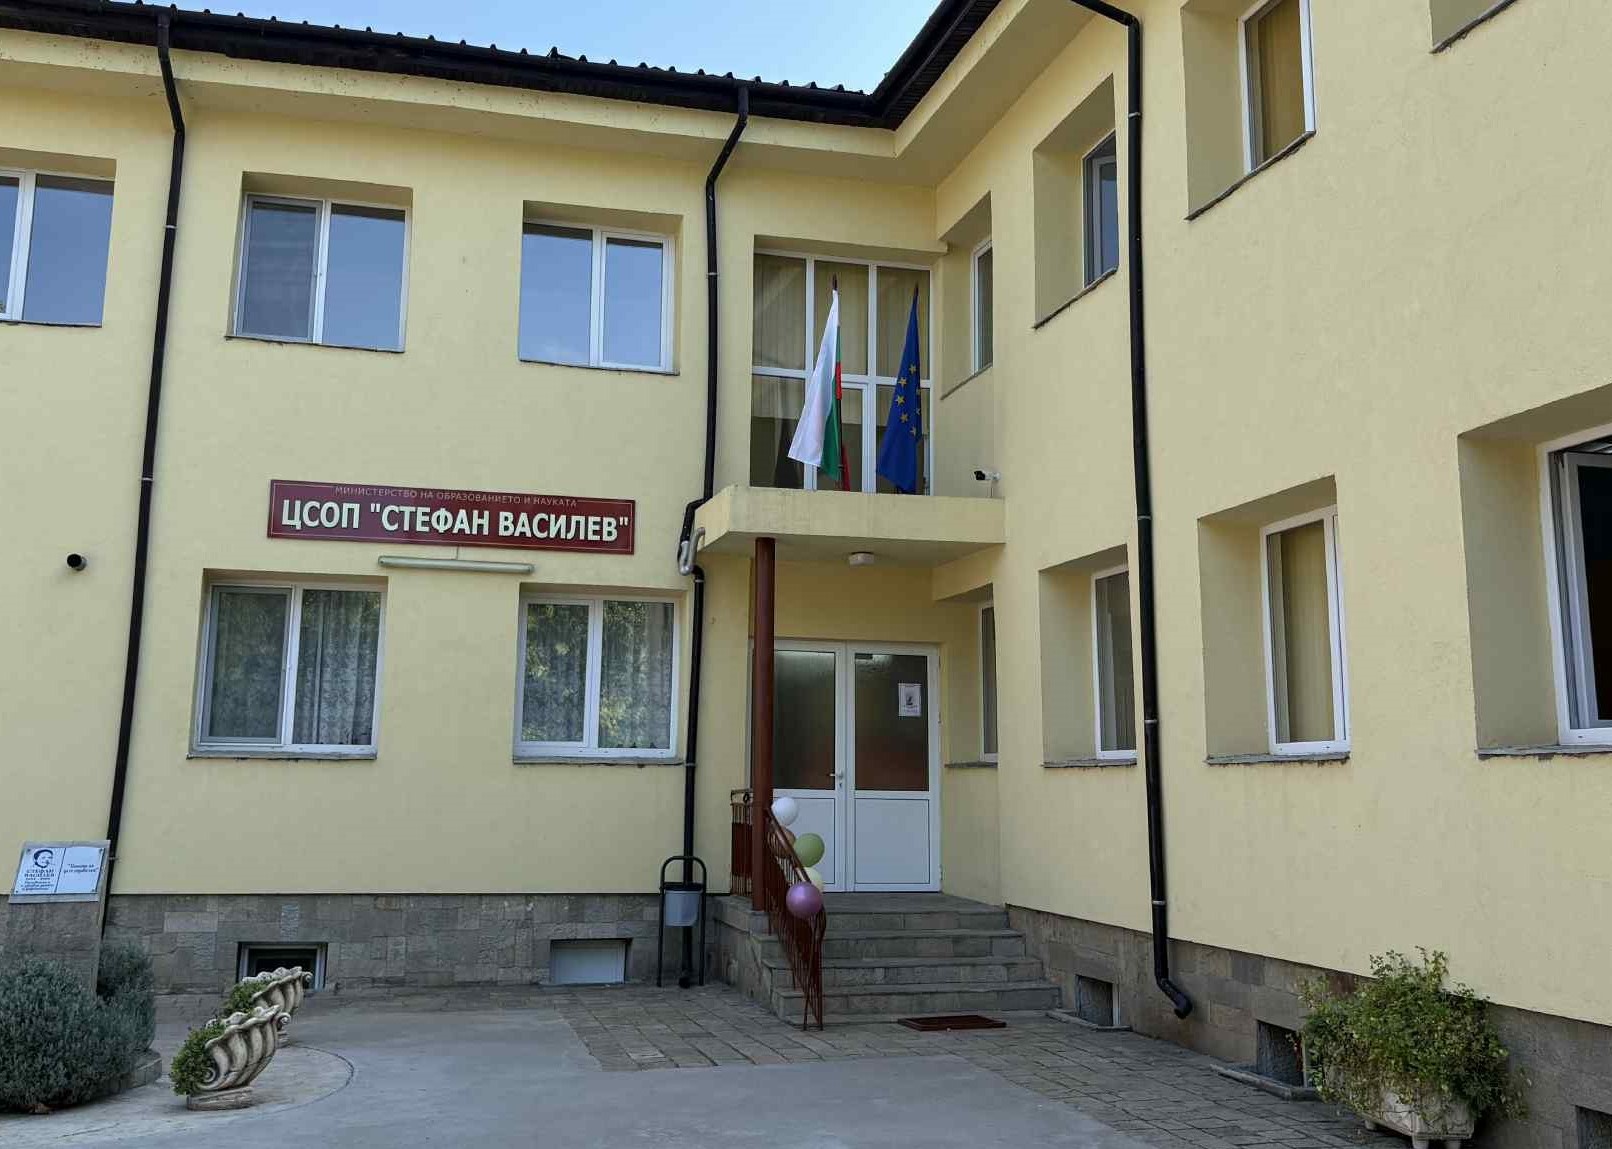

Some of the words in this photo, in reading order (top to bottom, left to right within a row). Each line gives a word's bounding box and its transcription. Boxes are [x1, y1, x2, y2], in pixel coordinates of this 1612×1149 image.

[334, 486, 417, 498] МИНИСТЕРСТВО
[420, 490, 433, 499] НА
[436, 491, 521, 504] ОБРАЗОВАНИЕТО
[523, 496, 531, 504] И
[533, 496, 577, 507] НАУКАТА
[281, 499, 360, 530] ЦСОП
[370, 503, 490, 535] "СТЕФАН
[498, 511, 629, 542] ВАСИЛЕВ"
